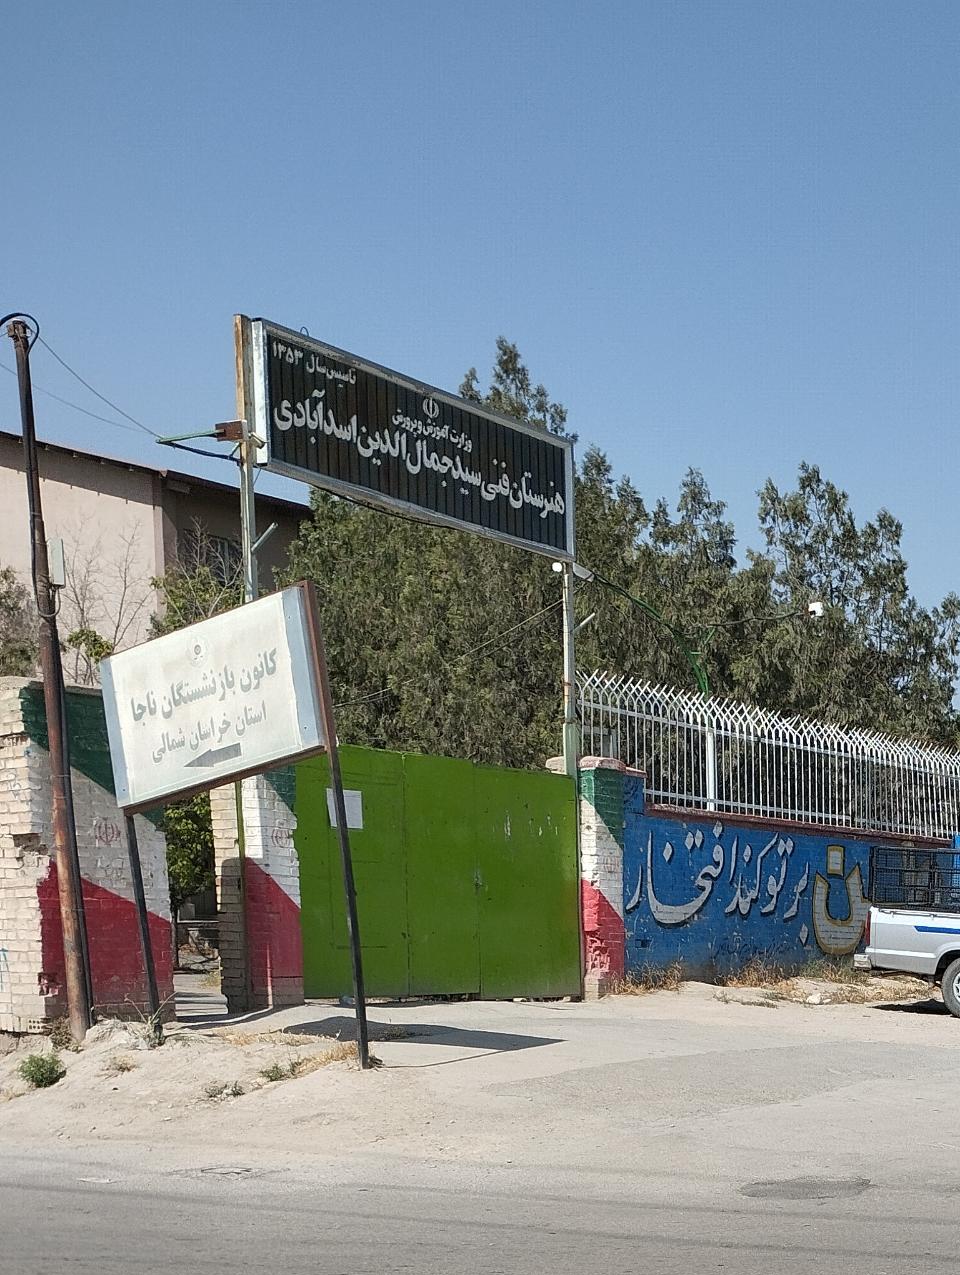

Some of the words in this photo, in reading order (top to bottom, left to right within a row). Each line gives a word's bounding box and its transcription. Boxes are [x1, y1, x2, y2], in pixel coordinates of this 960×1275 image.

[306, 354, 327, 374] سال
[392, 408, 418, 438] پرورش
[423, 418, 450, 440] آموزش
[449, 430, 472, 453] وزارت
[451, 455, 482, 495] سید
[481, 458, 510, 501] فنی
[509, 471, 565, 519] هنرستان
[239, 647, 278, 692] کانون
[130, 690, 157, 726] ناجا
[161, 664, 236, 719] بازنشستگان
[189, 712, 231, 751] خراسان
[235, 701, 267, 736] استان
[152, 727, 186, 763] شمالی
[625, 820, 738, 926] افتخار
[724, 832, 779, 915] کند
[761, 837, 794, 913] تو
